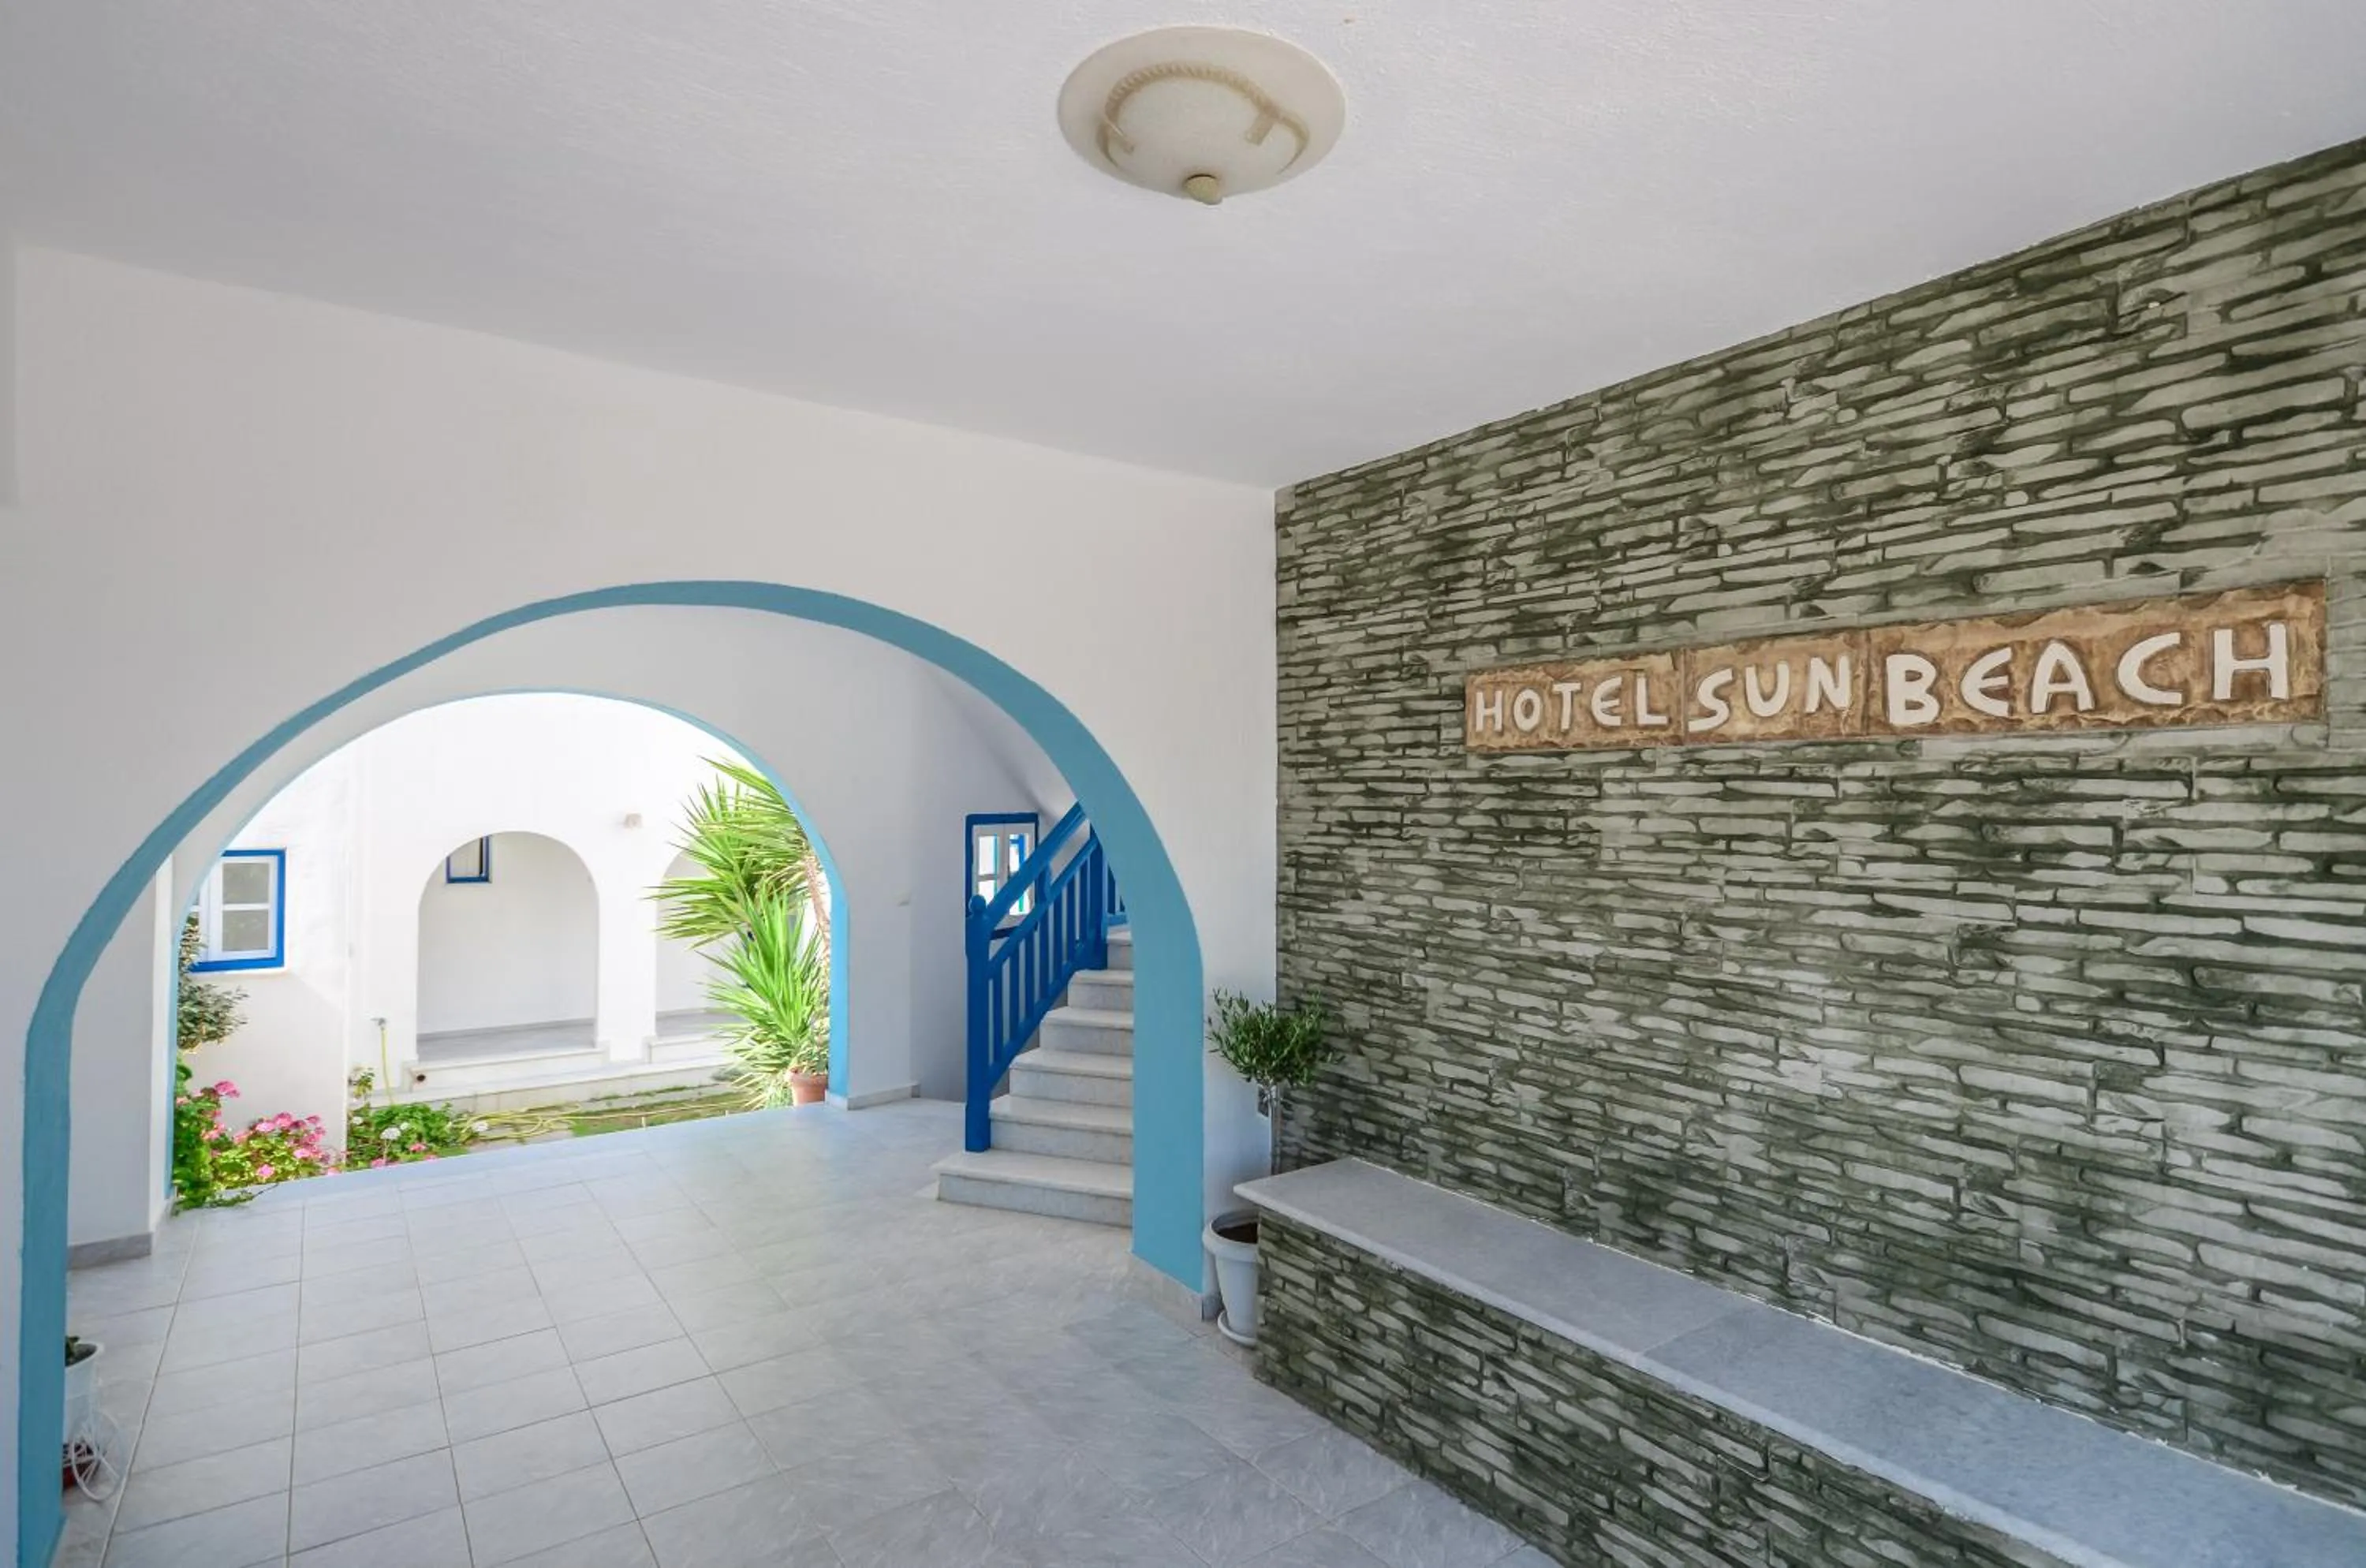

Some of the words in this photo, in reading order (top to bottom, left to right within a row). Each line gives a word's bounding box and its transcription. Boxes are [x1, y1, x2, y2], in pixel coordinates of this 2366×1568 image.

[1475, 672, 1670, 733] HOTEL
[1688, 654, 1853, 733] SUN
[1886, 622, 2288, 726] BEACH
